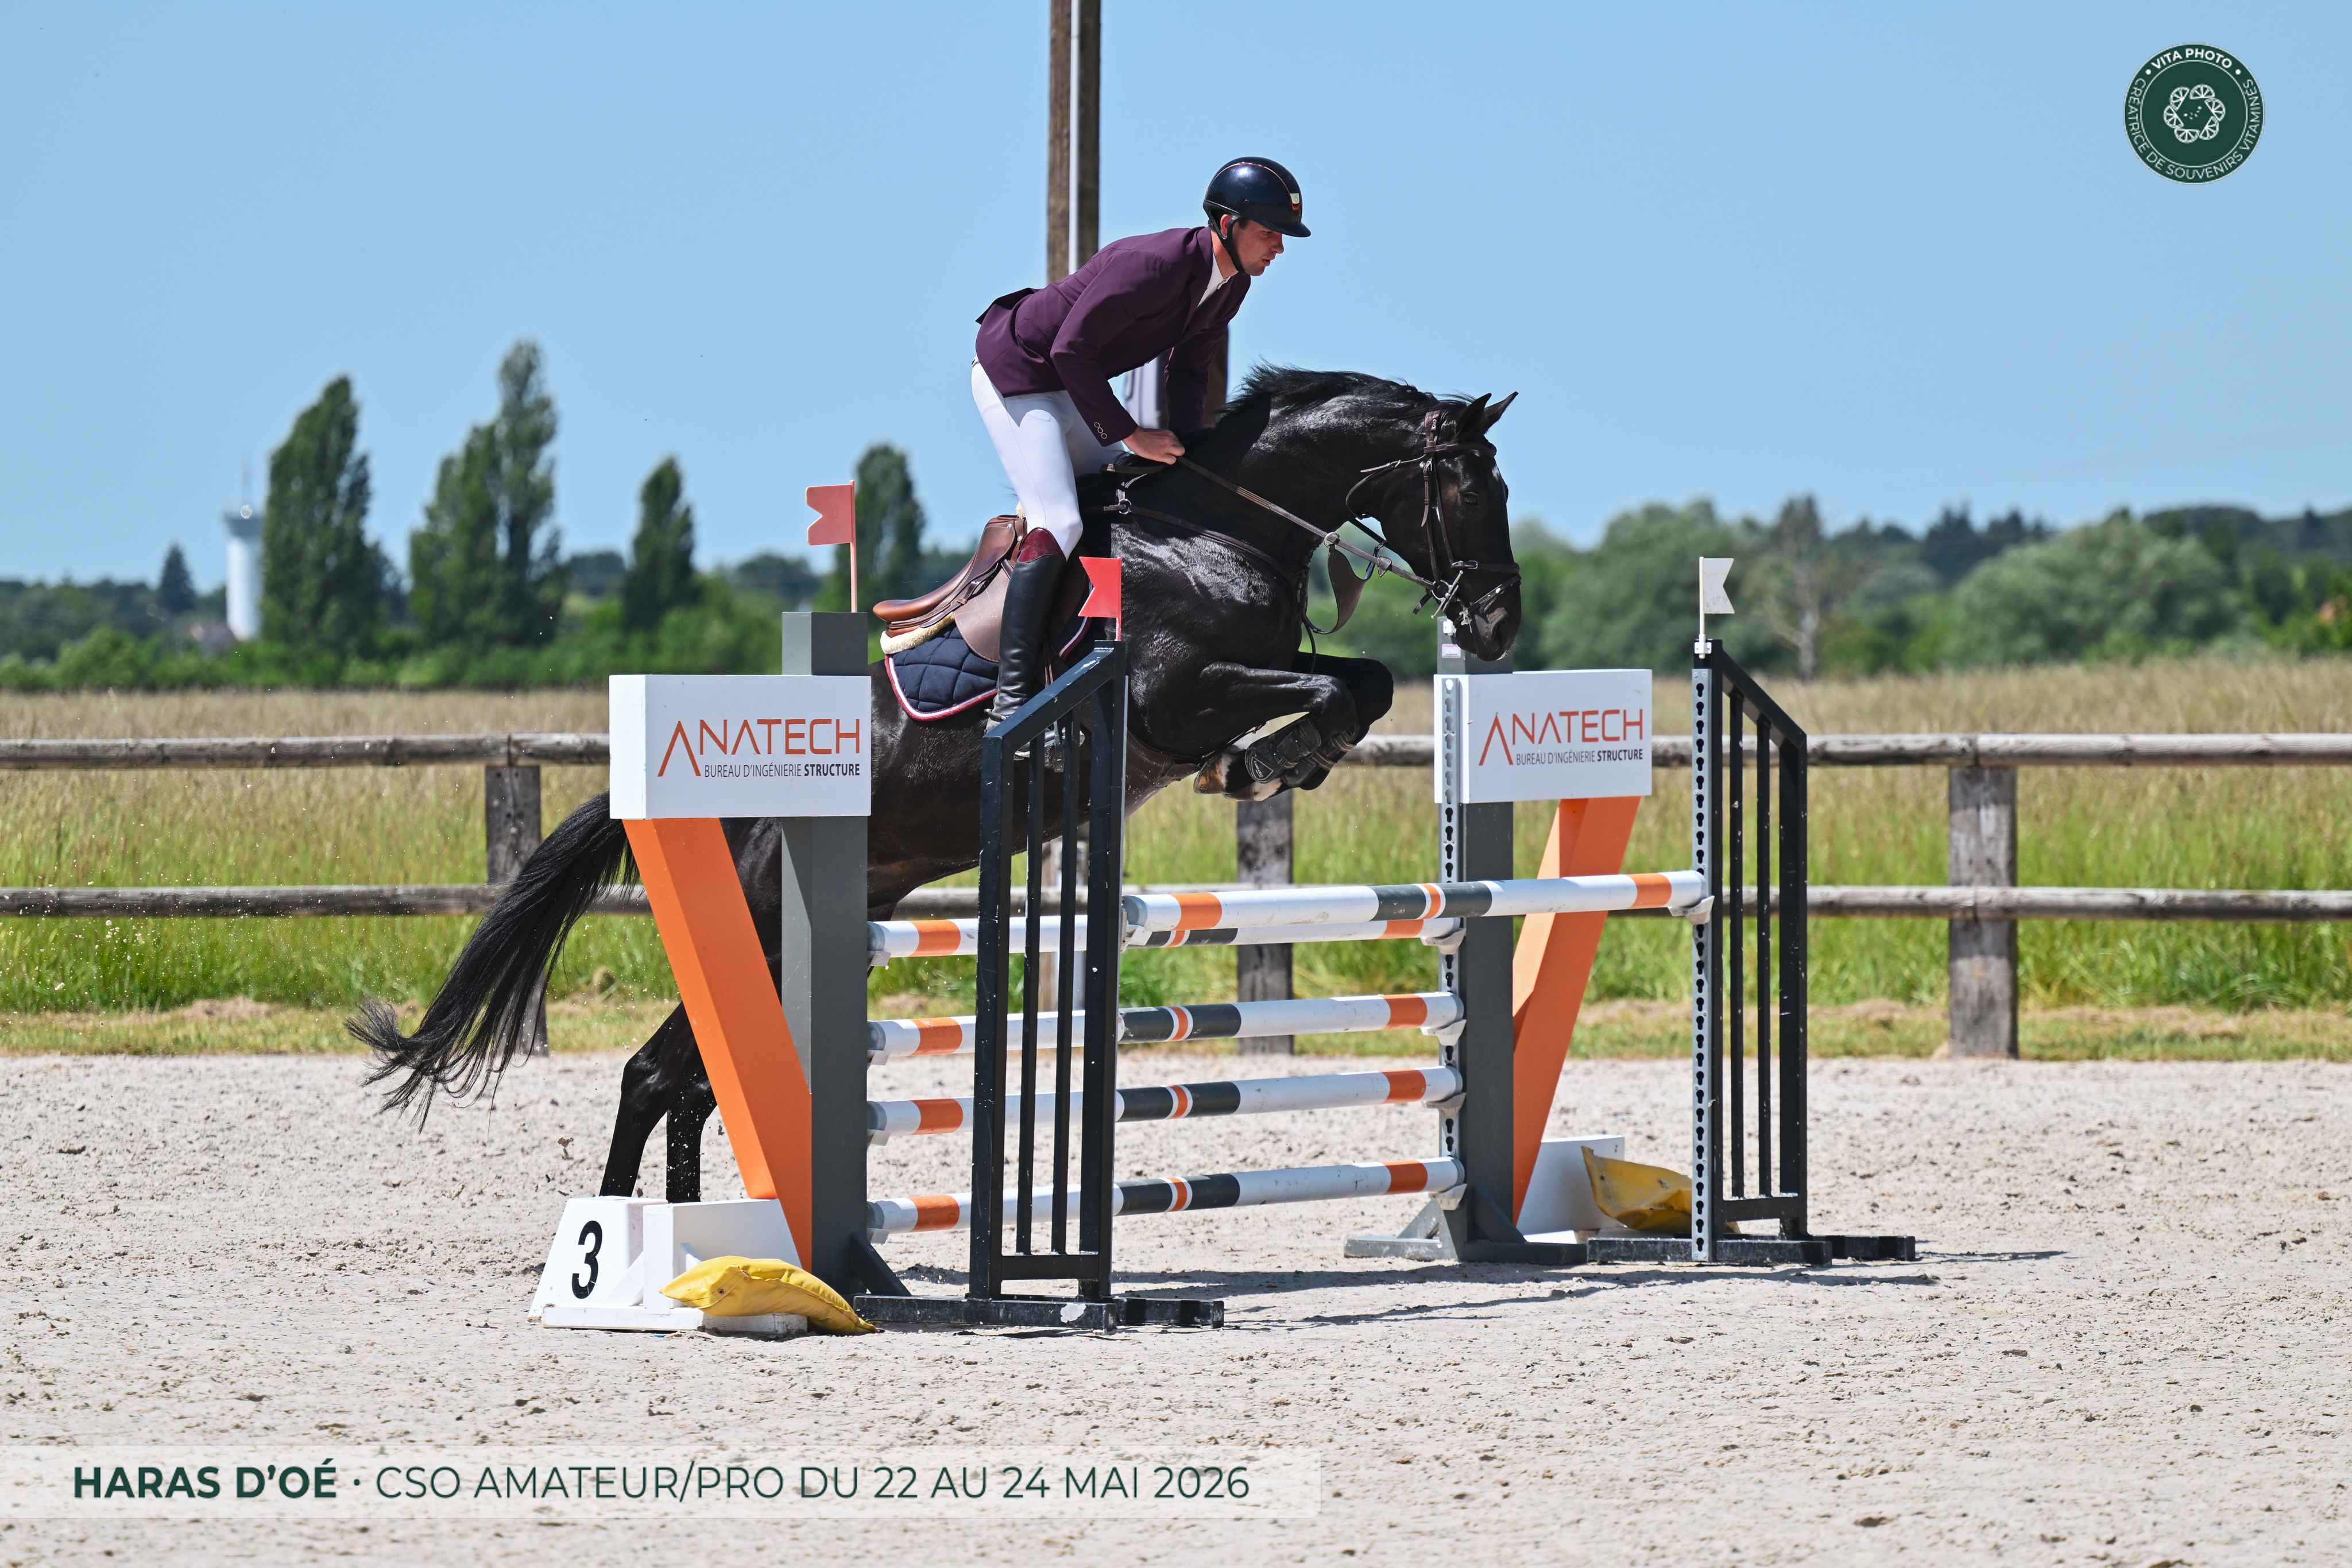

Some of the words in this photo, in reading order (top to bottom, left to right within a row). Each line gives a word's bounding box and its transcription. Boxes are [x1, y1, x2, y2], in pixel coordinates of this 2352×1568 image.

[658, 718, 860, 777] ANATECH
[1479, 709, 1643, 765] ANATECH
[1517, 753, 1546, 765] BUREAU
[1548, 750, 1595, 764] D'INGÉNIERIE
[1597, 749, 1643, 762] STRUCTURE
[705, 765, 741, 778] BUREAU
[743, 761, 802, 777] D'INGÉNIERIE
[804, 763, 860, 777] STRUCTURE
[571, 1221, 603, 1299] 3
